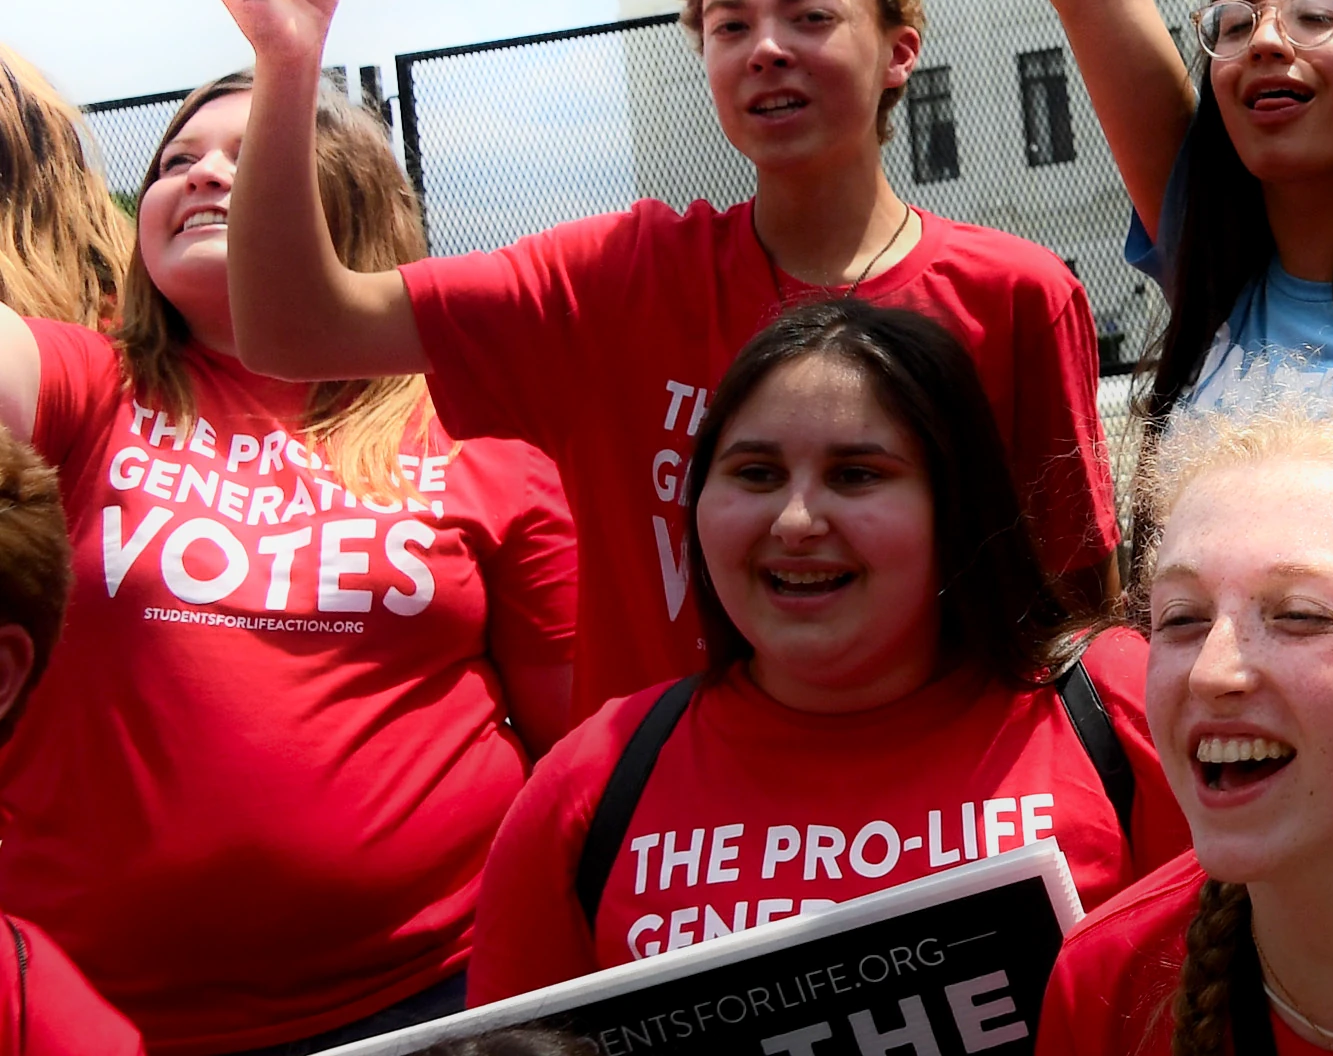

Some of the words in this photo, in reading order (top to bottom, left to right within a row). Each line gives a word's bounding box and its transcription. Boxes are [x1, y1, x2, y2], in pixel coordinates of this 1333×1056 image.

[131, 399, 217, 459] THE
[101, 504, 437, 617] VOTES
[143, 605, 364, 635] STUDENTSFORLIFEACTION.ORG
[630, 822, 742, 895] THE
[762, 792, 1057, 881] PRO-LIFE
[598, 938, 946, 1056] ENTSFORLIFE.ORG
